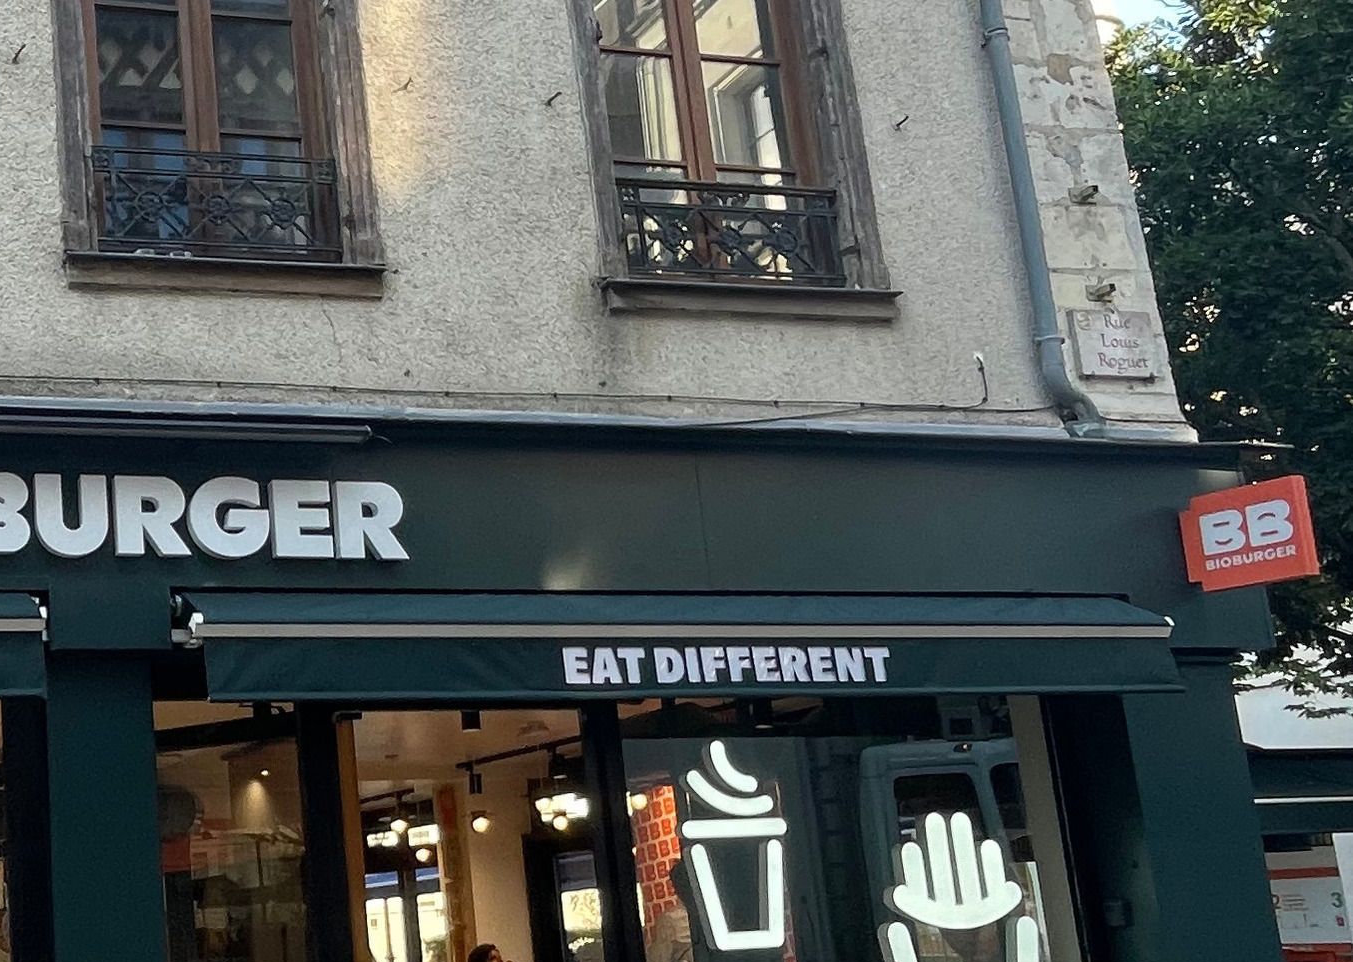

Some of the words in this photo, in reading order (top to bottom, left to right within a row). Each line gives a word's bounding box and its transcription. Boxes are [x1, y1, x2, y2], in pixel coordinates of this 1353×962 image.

[1103, 314, 1131, 329] Rue
[1100, 333, 1140, 348] Louis
[1097, 352, 1150, 374] Roguet
[1199, 499, 1294, 556] BB
[1205, 544, 1297, 571] BIOBURGER
[562, 646, 645, 684] EAT
[653, 645, 890, 683] DIFFERENT
[1330, 891, 1343, 908] 3
